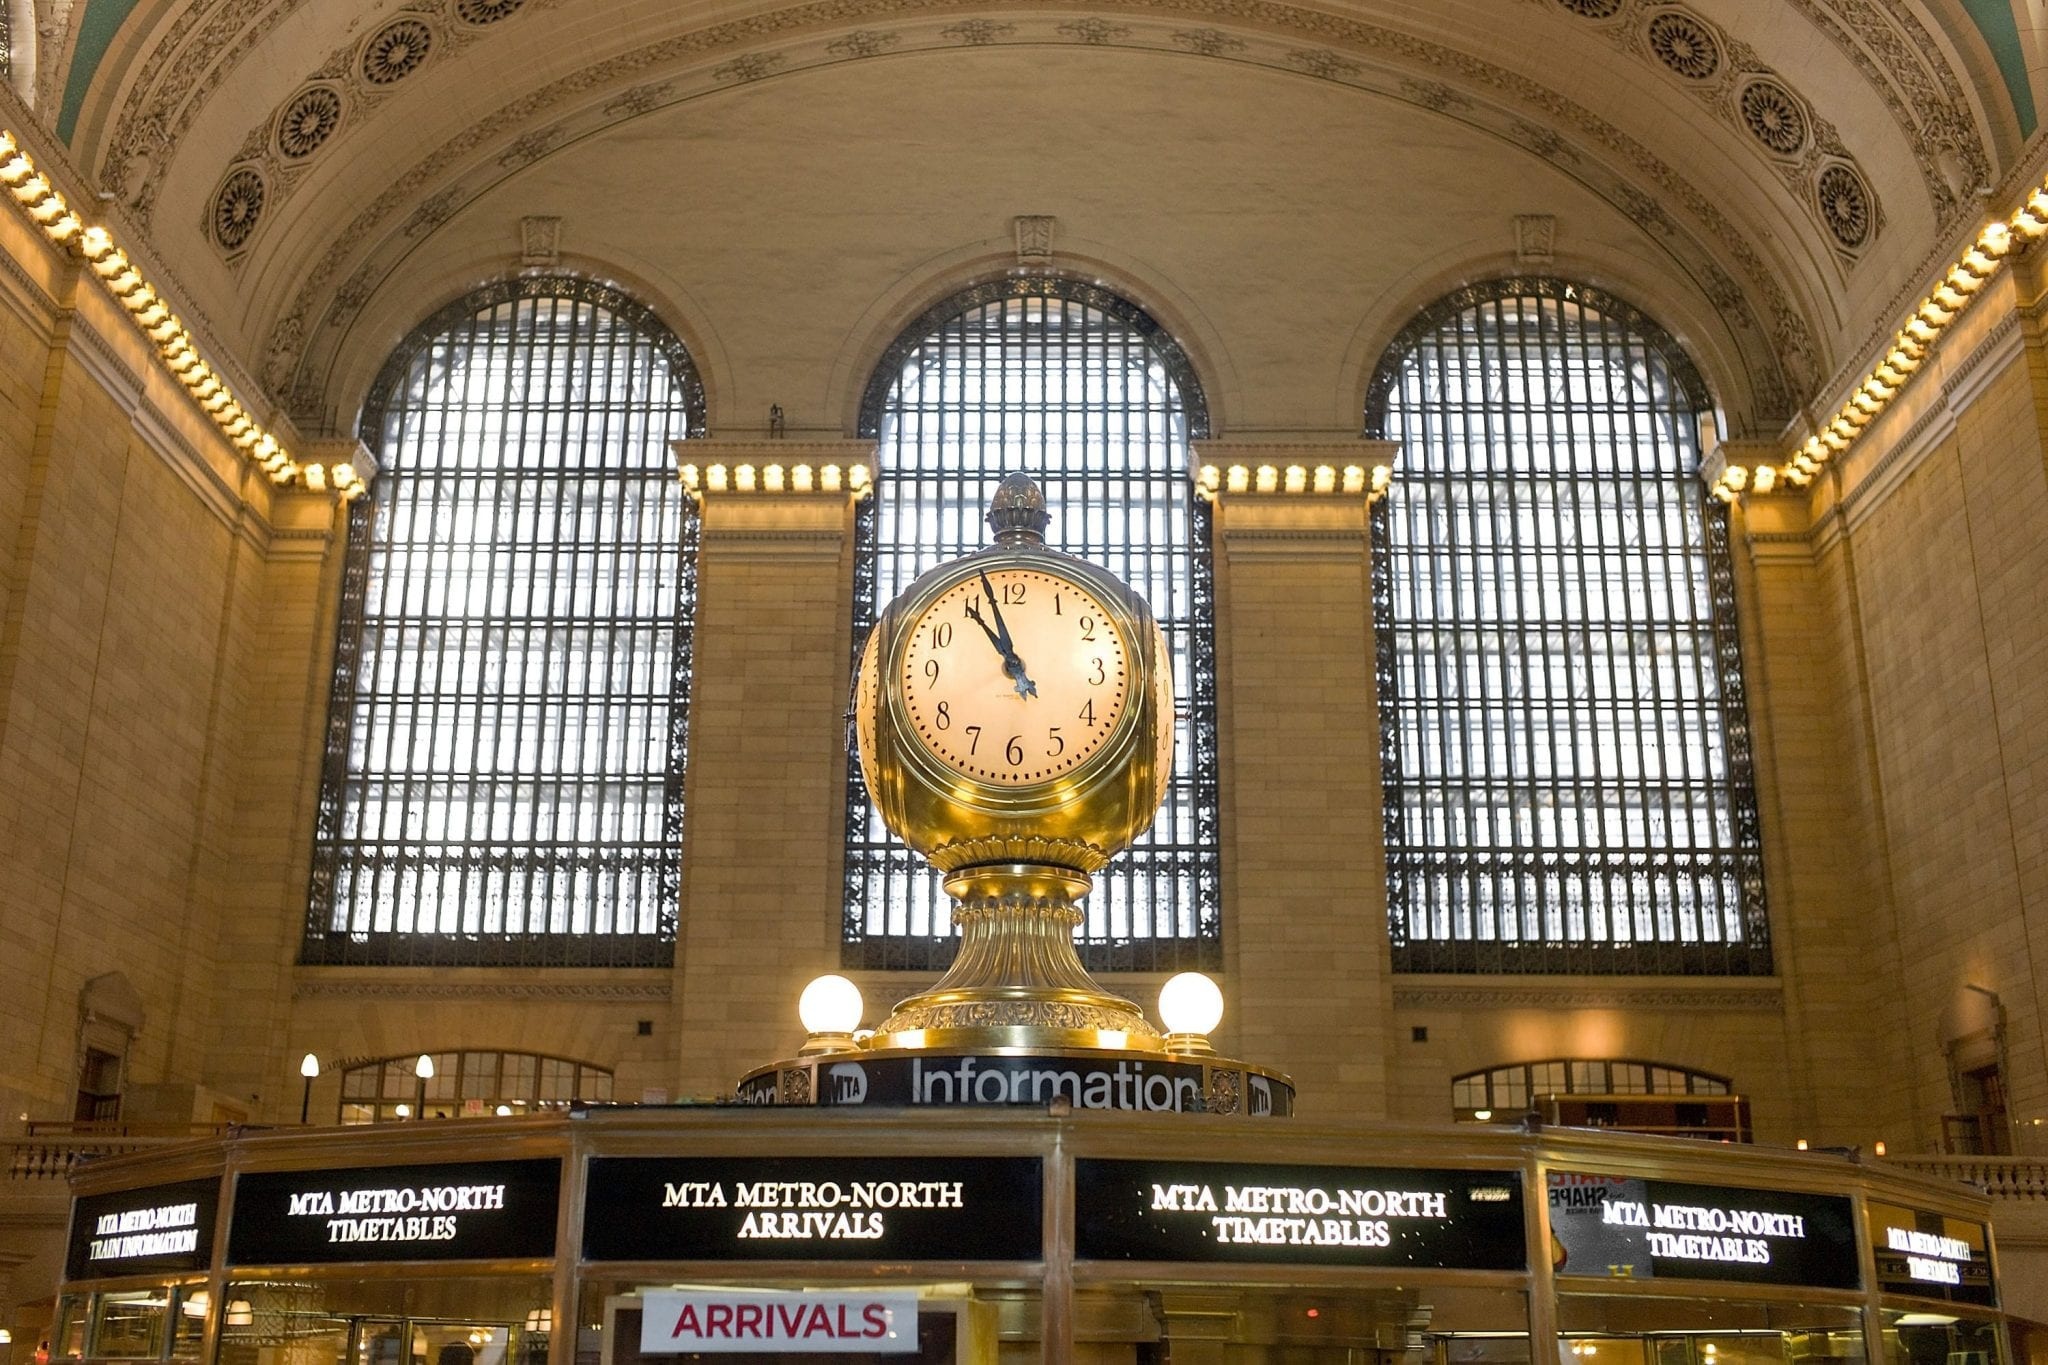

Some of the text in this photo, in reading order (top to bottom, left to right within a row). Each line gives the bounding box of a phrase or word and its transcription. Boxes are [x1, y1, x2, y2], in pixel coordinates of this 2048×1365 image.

[1003, 583, 1026, 605] 12
[1054, 593, 1062, 616] 1
[932, 622, 953, 650] 10
[1079, 617, 1096, 642] 2
[925, 659, 940, 690] 9
[1088, 657, 1106, 686] 3
[935, 701, 951, 731] 8
[1078, 698, 1098, 728] 4
[965, 725, 982, 756] 7
[1005, 735, 1024, 767] 6
[1046, 727, 1065, 757] 5
[912, 1056, 1200, 1113] Information
[288, 1185, 506, 1216] MTA METRO-NORTH
[663, 1182, 964, 1208] MTA METRO-NORTH
[1151, 1184, 1447, 1218] MTA METRO-NORTH
[96, 1203, 198, 1235] MTA METRO-NORTH
[326, 1216, 457, 1243] TIMETABLES
[737, 1212, 884, 1239] ARRIVALS
[1211, 1216, 1391, 1247] TIMETABLES
[1601, 1200, 1805, 1238] MTA METRO-NORTH
[90, 1238, 121, 1260] TRAIN
[1646, 1232, 1770, 1264] TIMETABLES
[671, 1303, 887, 1338] ARRIVALS
